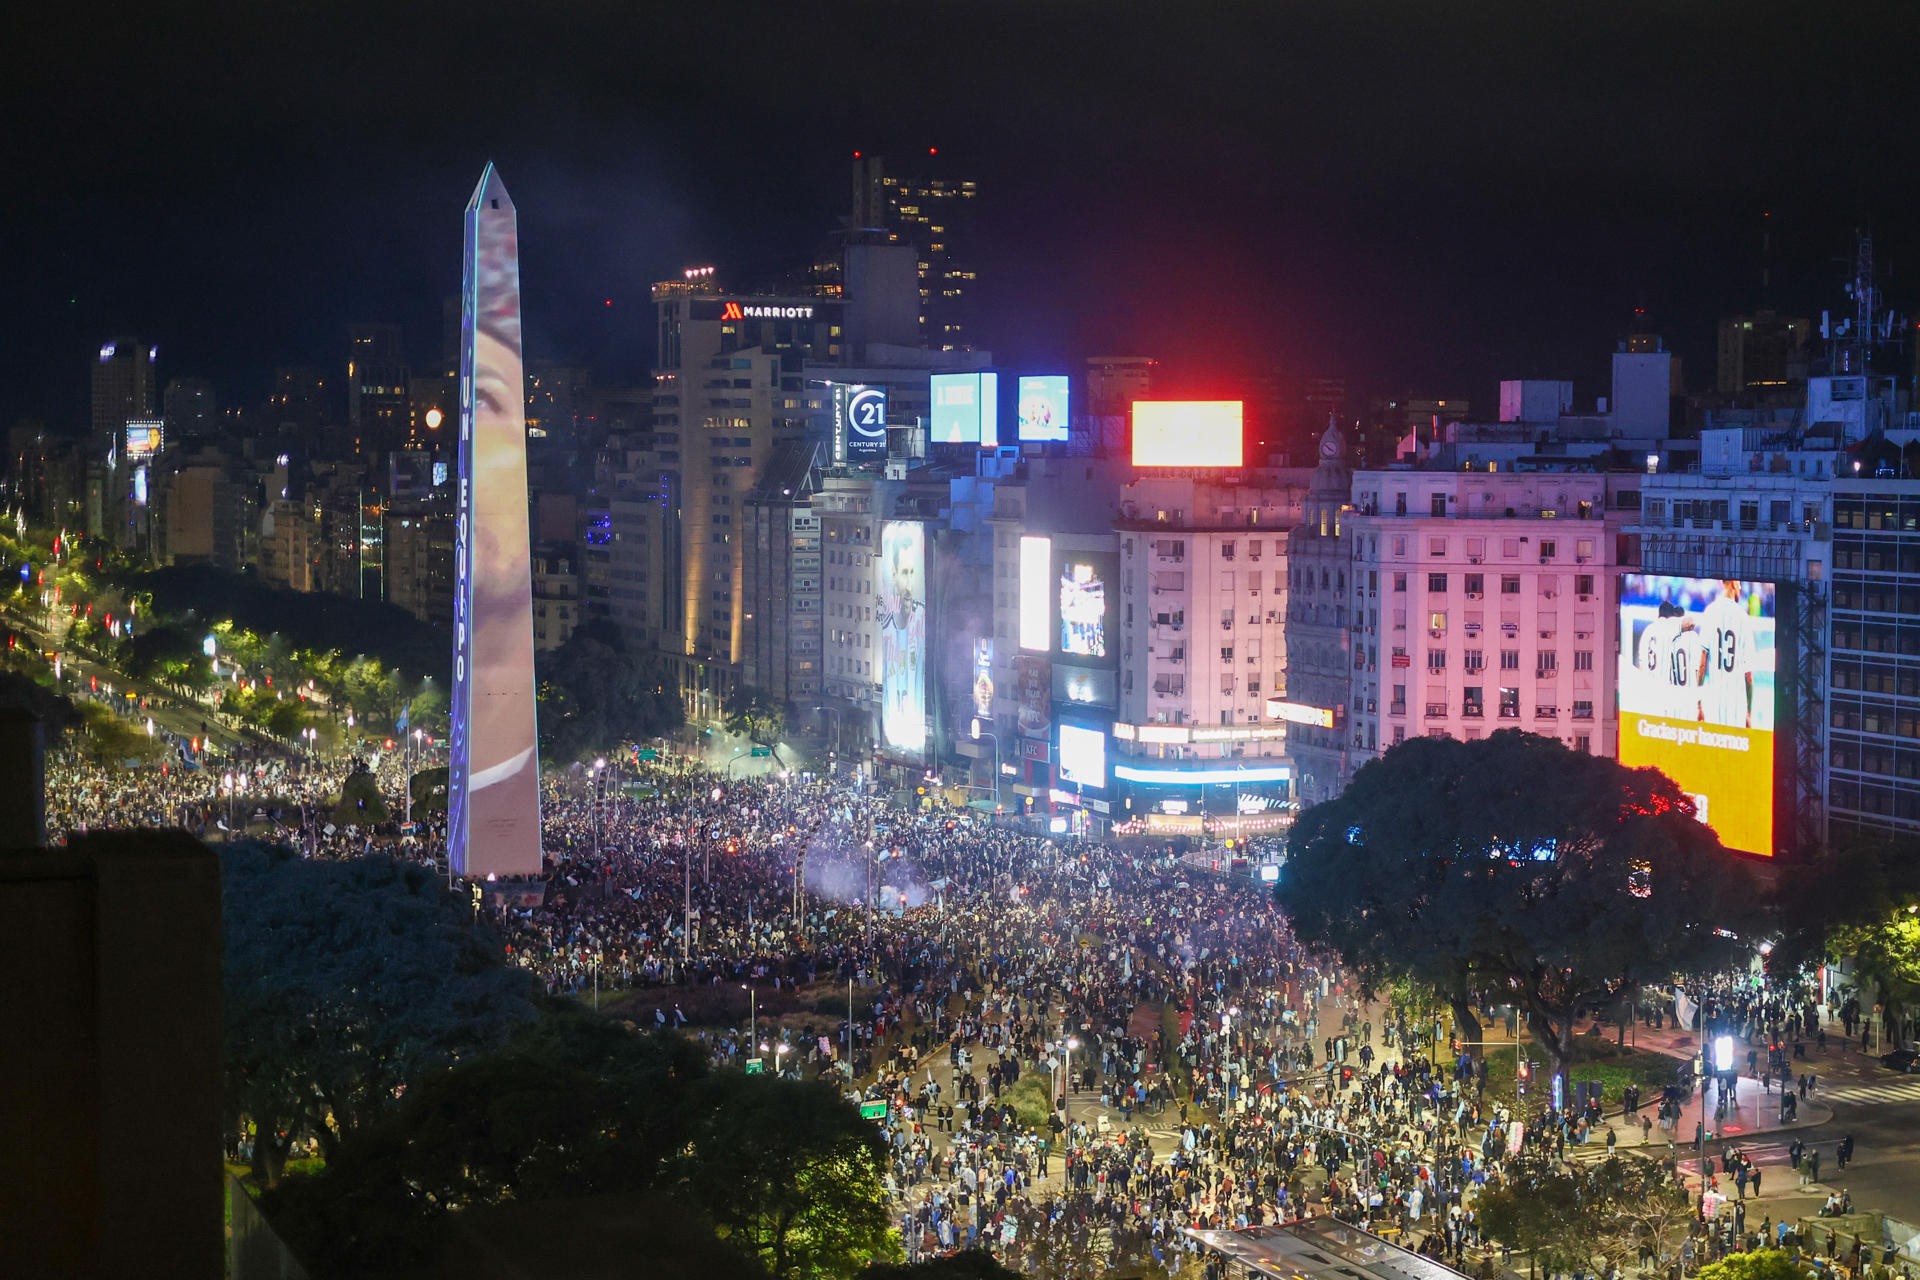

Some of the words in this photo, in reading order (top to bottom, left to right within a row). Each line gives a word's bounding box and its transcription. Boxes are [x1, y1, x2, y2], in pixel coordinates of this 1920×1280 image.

[743, 306, 813, 318] MARRIOTT
[462, 376, 470, 441] UN
[861, 403, 884, 425] 21
[457, 478, 468, 682] EQUIPO
[1670, 648, 1687, 686] 10
[1717, 627, 1735, 672] 13
[1025, 744, 1038, 755] KFC
[1638, 719, 1677, 741] Gracias
[1677, 728, 1696, 746] por
[1697, 726, 1750, 752] hacernos
